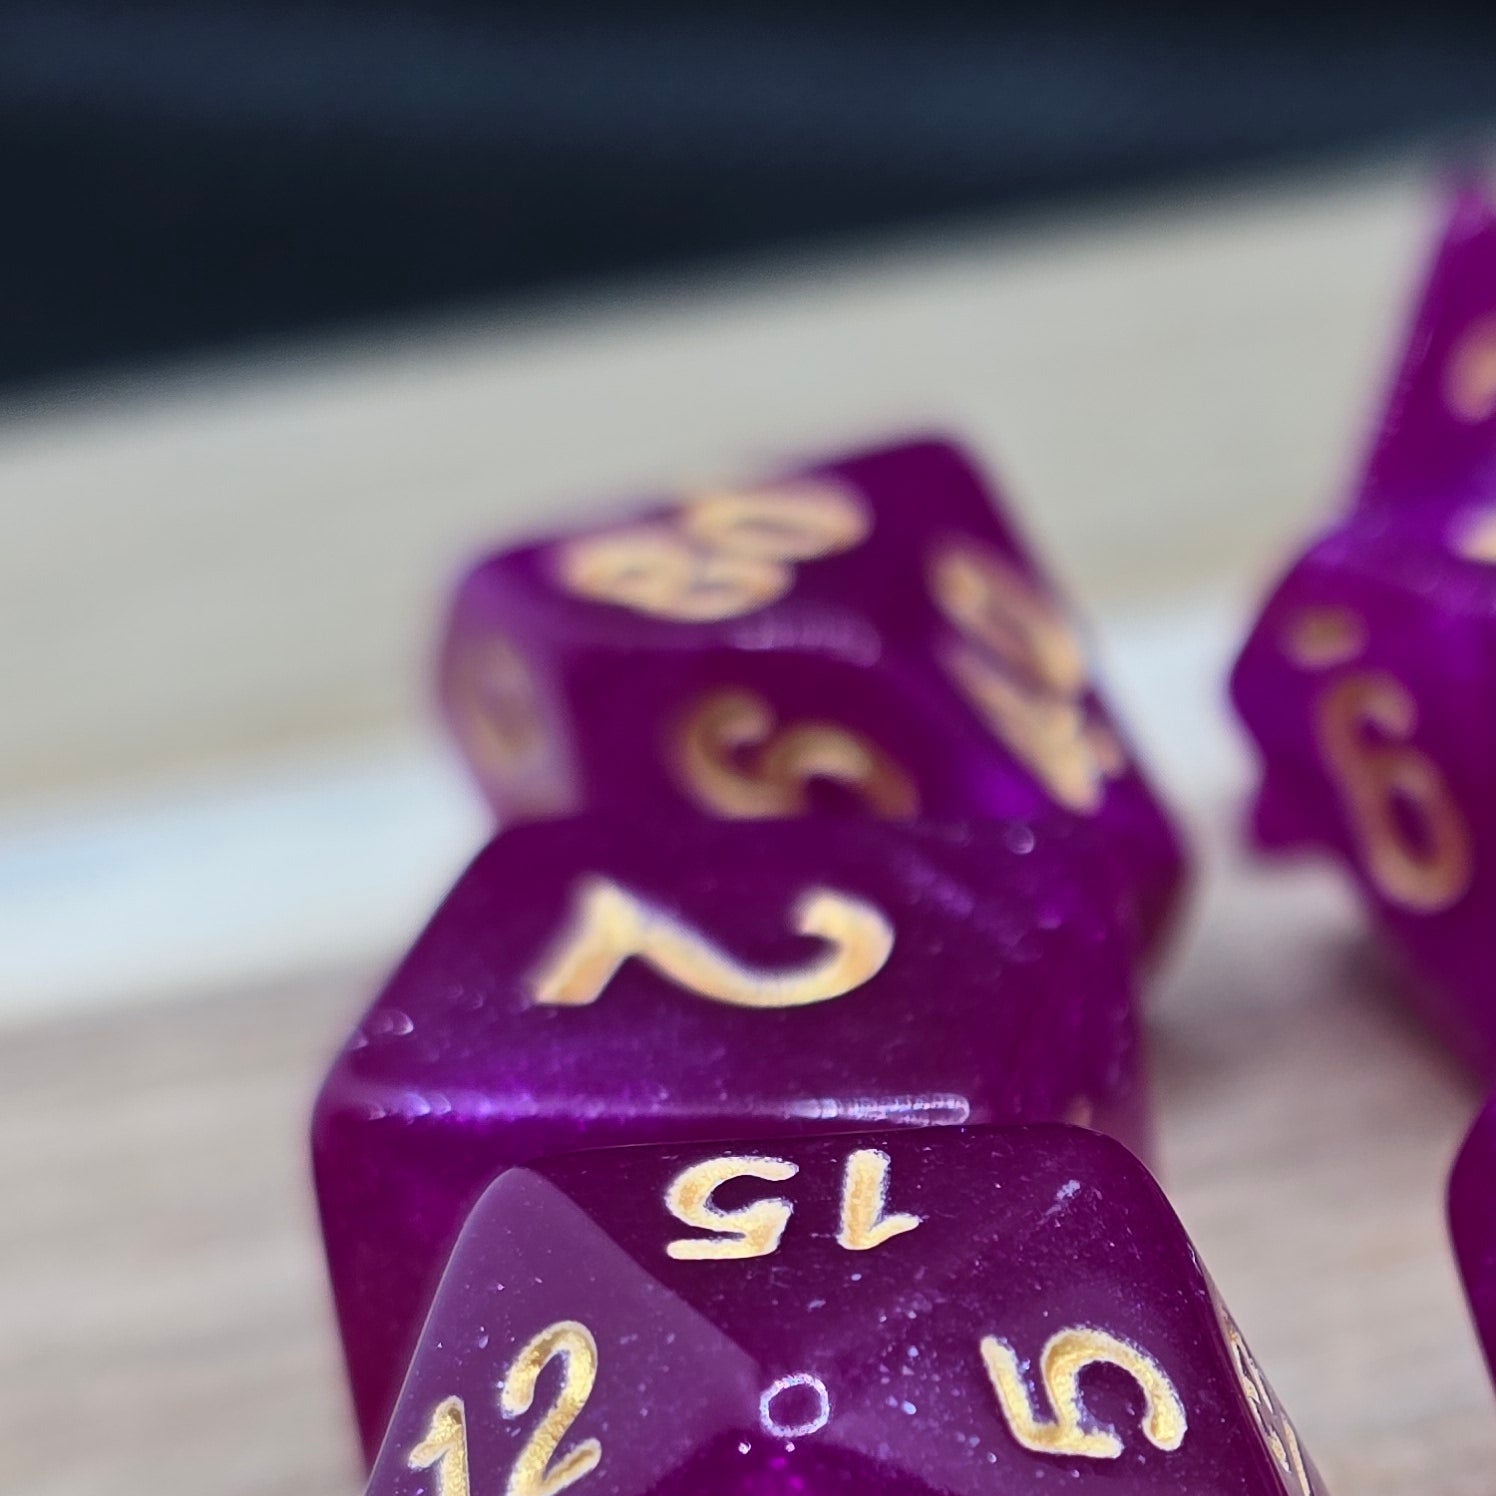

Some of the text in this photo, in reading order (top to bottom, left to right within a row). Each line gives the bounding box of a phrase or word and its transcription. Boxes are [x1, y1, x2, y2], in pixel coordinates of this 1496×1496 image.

[534, 875, 895, 1007] 2
[664, 1149, 924, 1262] 15
[980, 1326, 1188, 1460] 5
